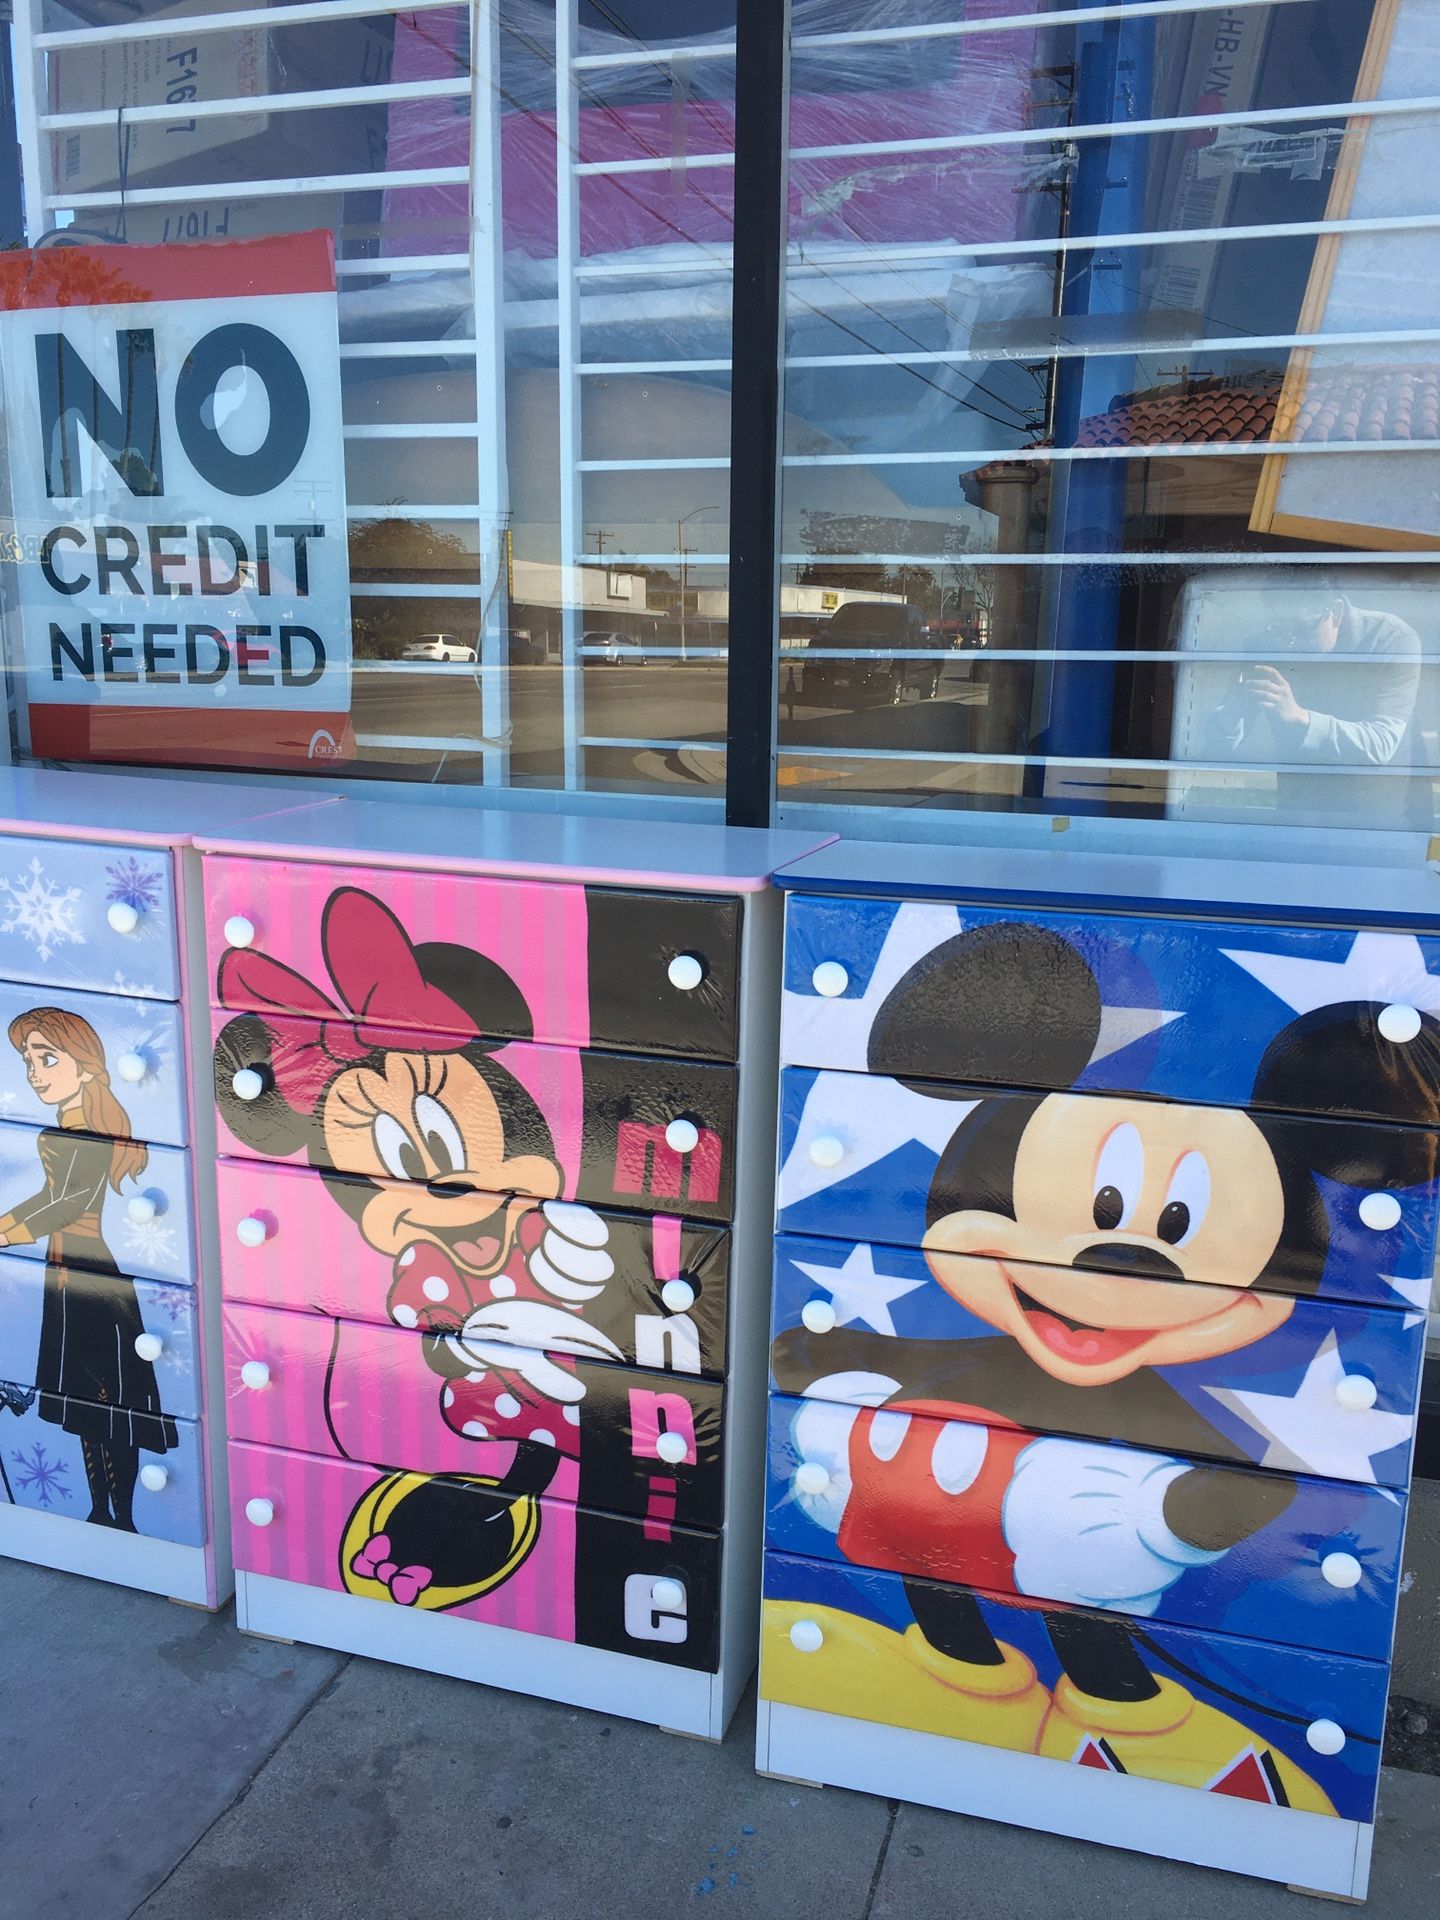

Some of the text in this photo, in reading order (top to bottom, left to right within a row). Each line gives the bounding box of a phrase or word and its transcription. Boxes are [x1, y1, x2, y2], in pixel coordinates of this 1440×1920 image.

[34, 322, 311, 498] NO
[40, 524, 326, 597] CREDIT
[48, 622, 327, 687] NEEDED
